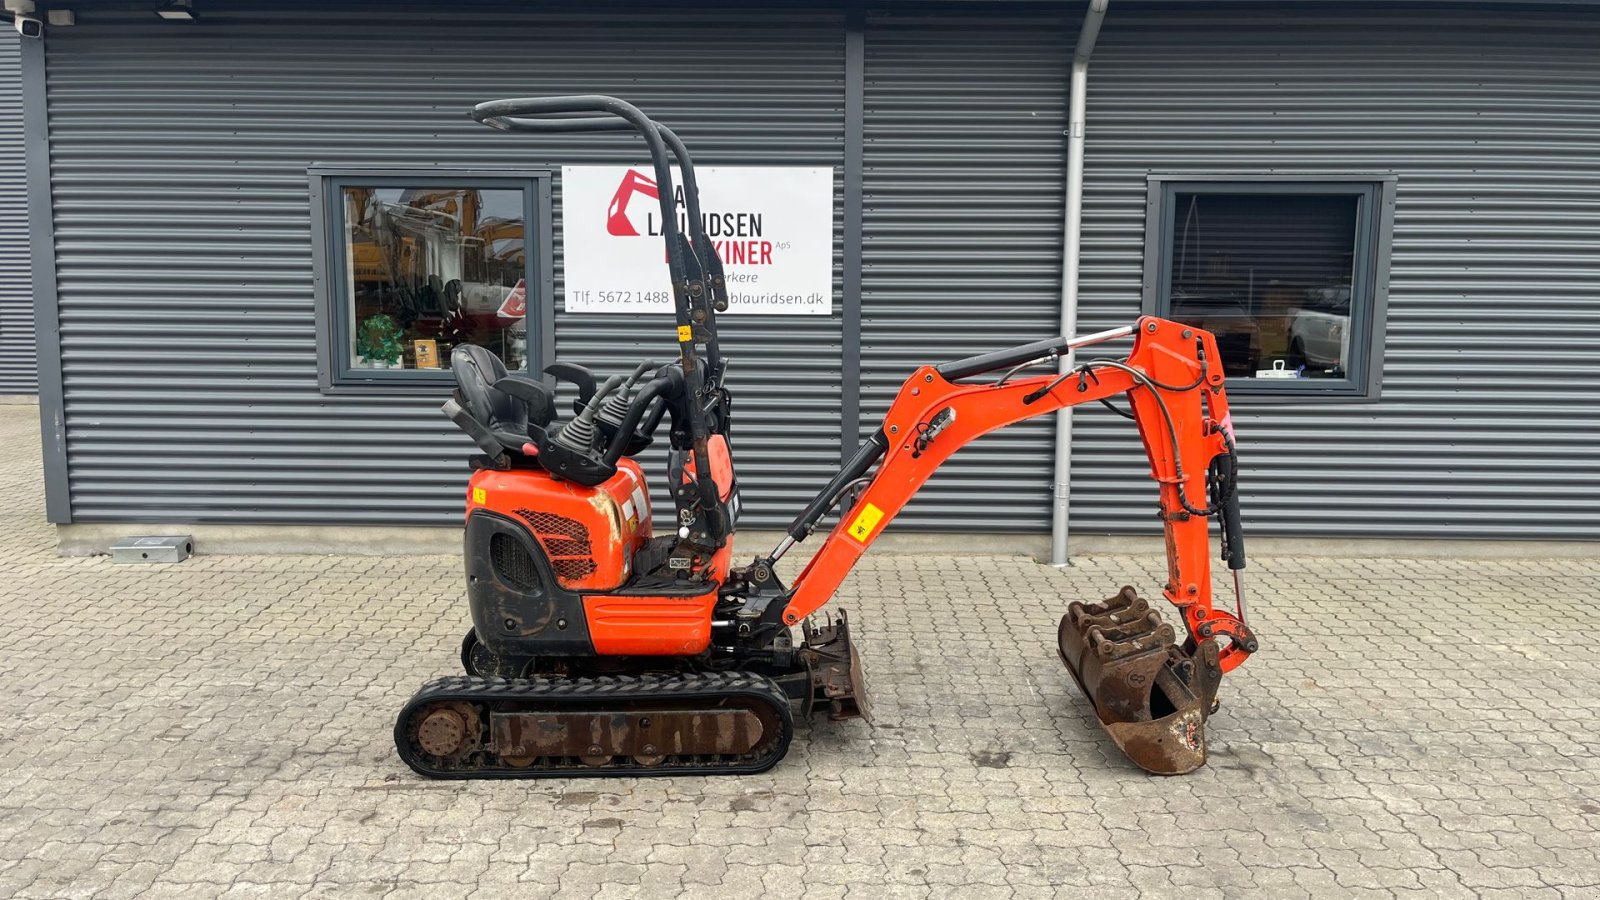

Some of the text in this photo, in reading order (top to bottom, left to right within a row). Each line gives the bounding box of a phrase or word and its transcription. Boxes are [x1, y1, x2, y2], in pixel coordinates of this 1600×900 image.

[775, 241, 791, 250] ApS
[573, 291, 824, 305] Tlf. 5672 1488 blauridsen.dk
